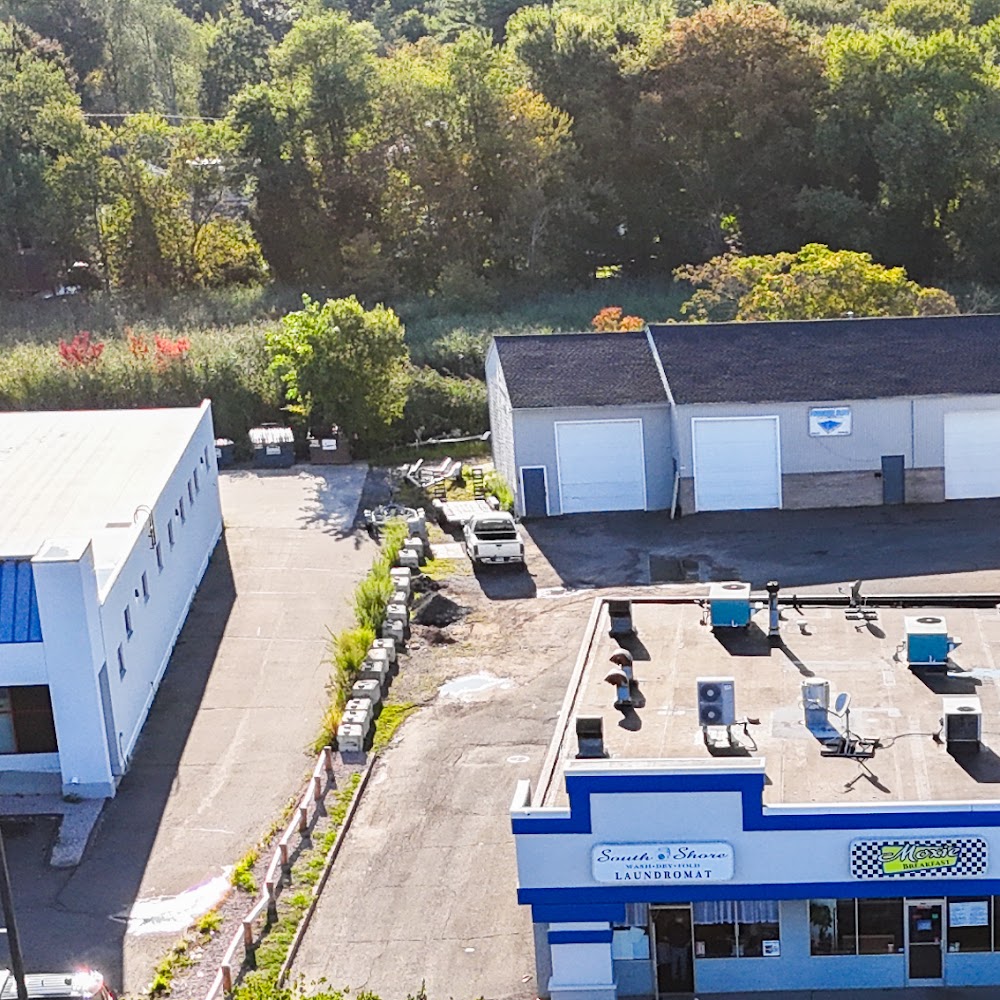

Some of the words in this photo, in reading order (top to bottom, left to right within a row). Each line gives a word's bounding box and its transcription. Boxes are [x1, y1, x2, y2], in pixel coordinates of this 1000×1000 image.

[597, 849, 652, 863] South
[673, 847, 728, 860] Shore
[878, 843, 961, 863] Moxie
[615, 870, 712, 881] LAUNDROMAT
